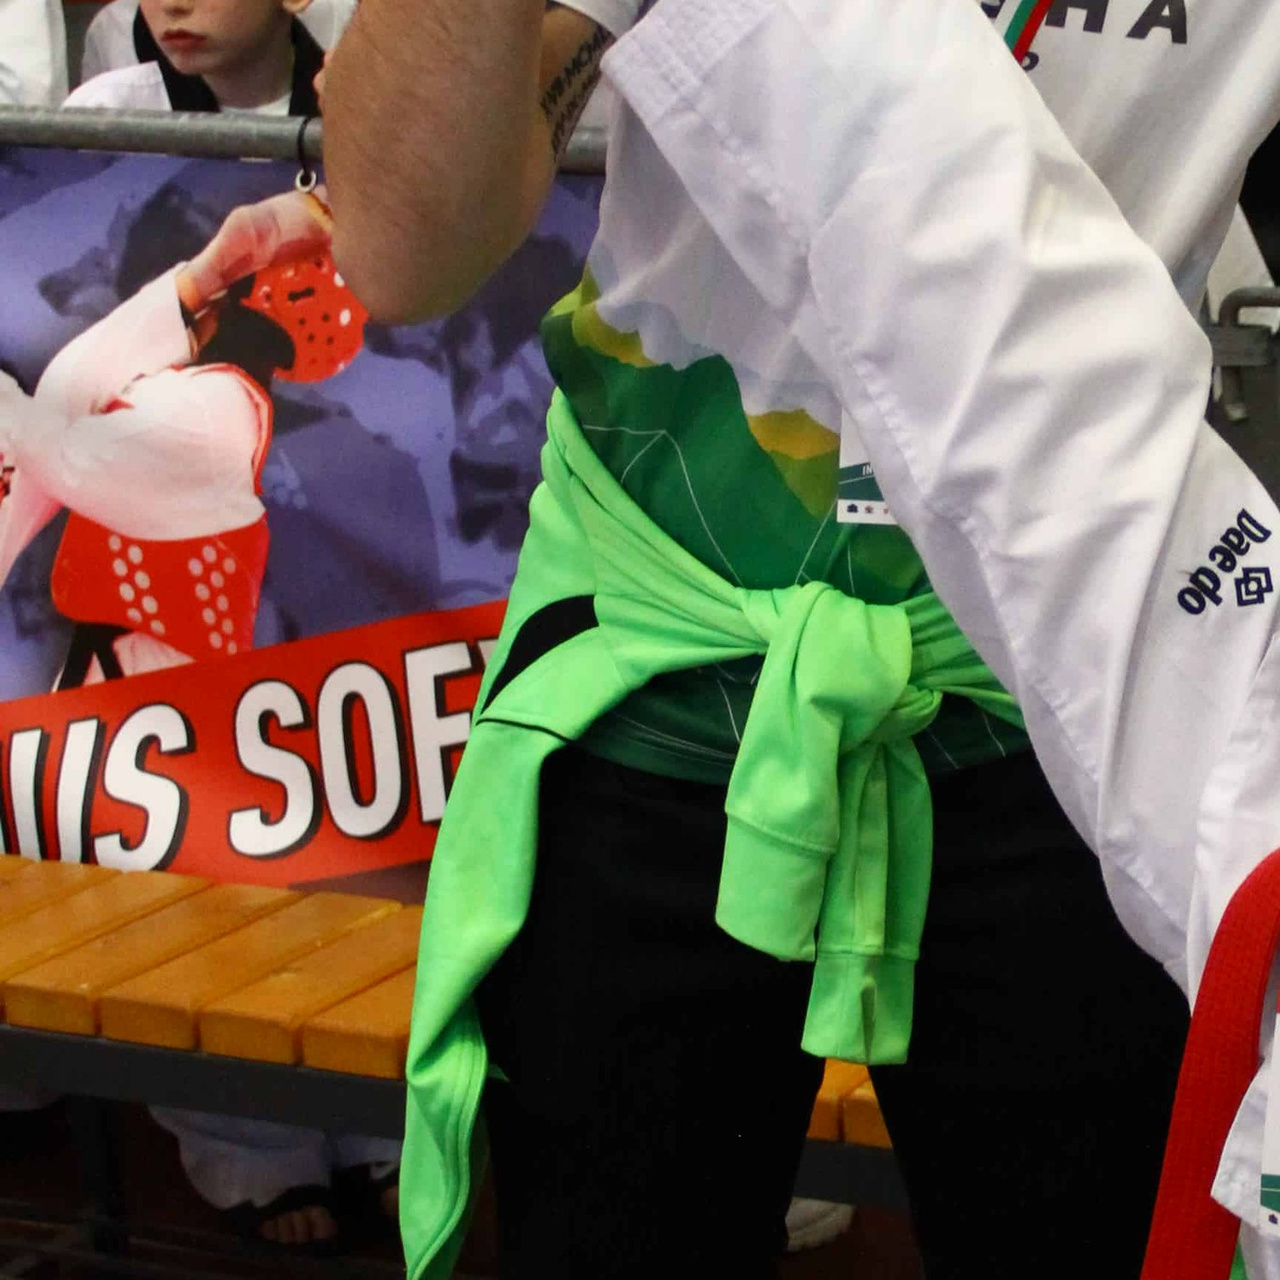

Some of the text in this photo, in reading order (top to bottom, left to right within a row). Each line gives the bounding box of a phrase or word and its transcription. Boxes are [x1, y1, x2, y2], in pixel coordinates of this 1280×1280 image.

[1177, 508, 1272, 616] Daedo
[0, 638, 494, 873] US SOF
